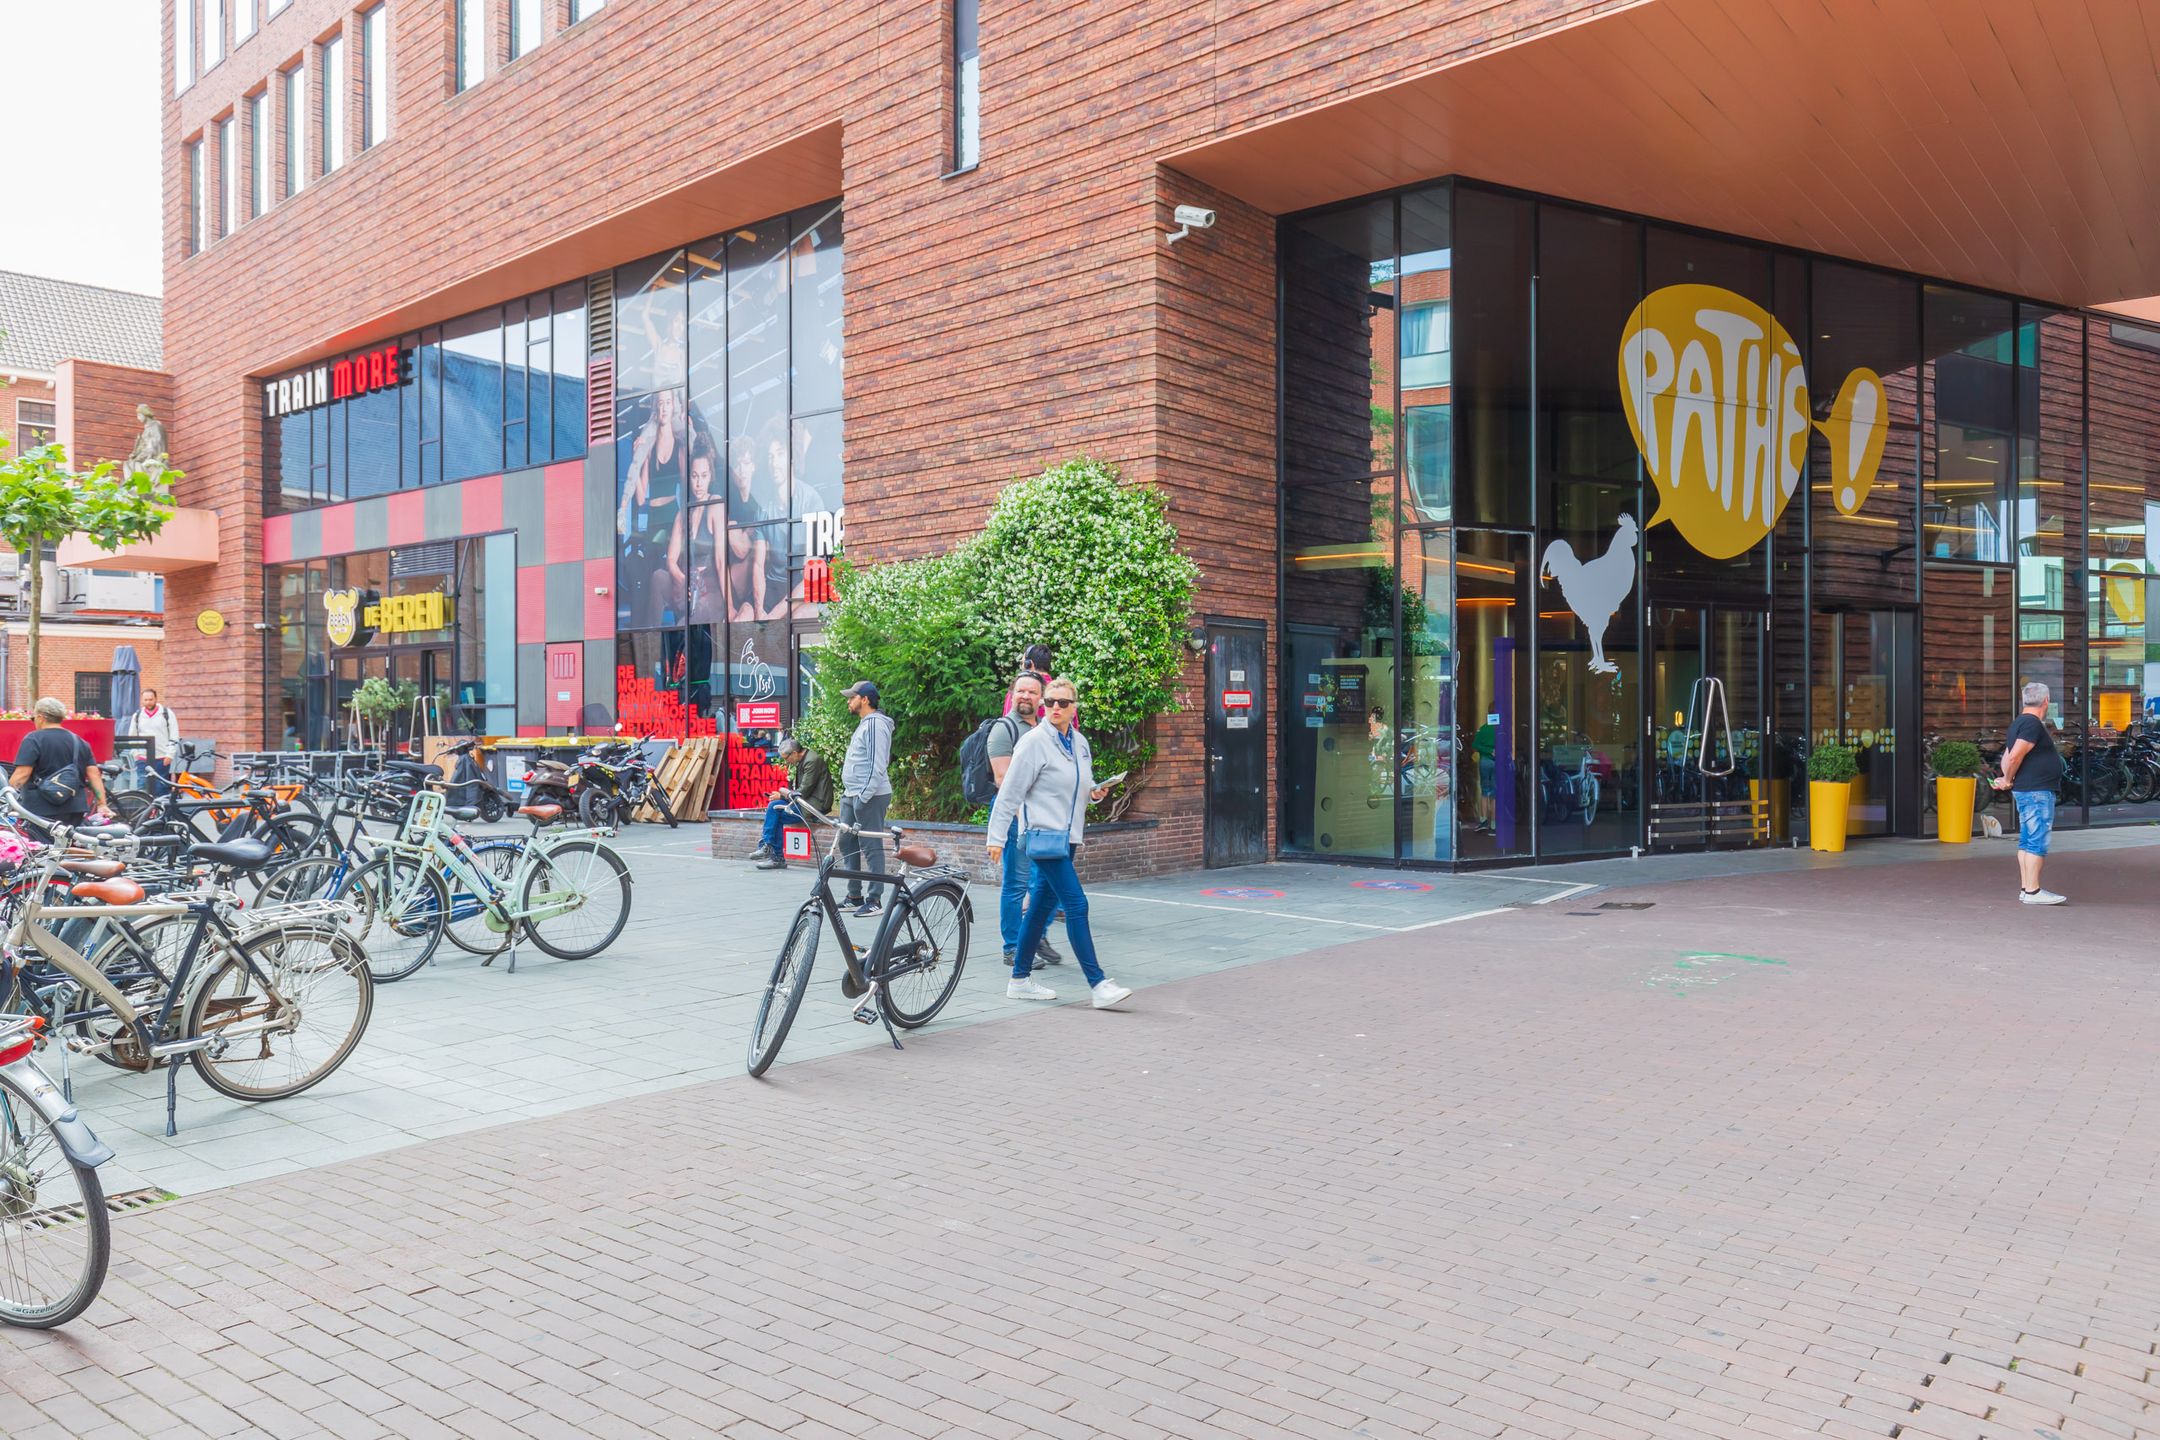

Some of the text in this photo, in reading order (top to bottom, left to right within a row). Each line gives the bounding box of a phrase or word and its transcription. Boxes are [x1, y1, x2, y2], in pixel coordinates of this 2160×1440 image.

[266, 346, 398, 417] TRAIN MORE
[381, 592, 444, 633] BEREN
[617, 665, 635, 679] RE
[617, 678, 655, 692] MORE
[618, 690, 679, 705] AINMORE
[794, 837, 799, 849] B
[22, 1304, 55, 1314] Gazelle
